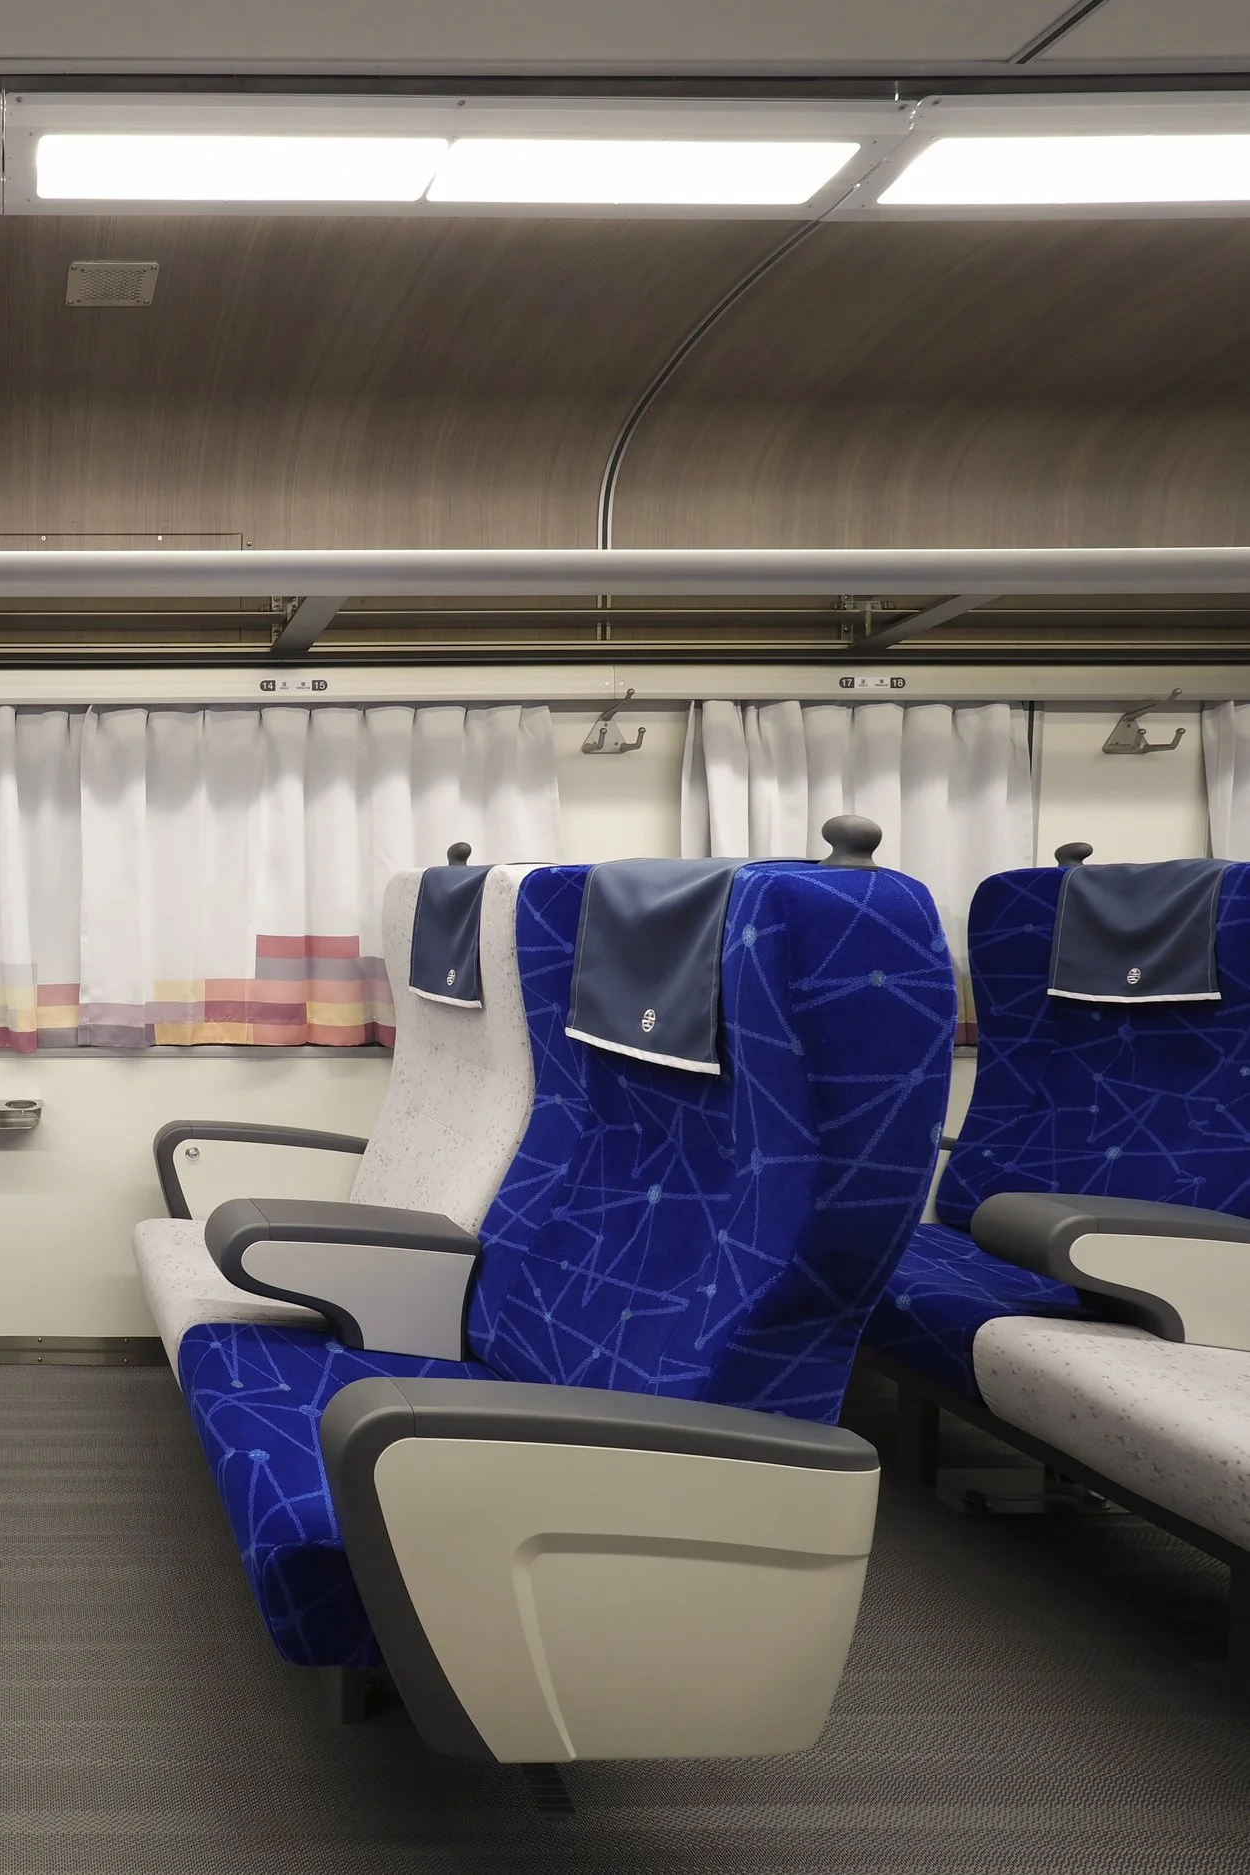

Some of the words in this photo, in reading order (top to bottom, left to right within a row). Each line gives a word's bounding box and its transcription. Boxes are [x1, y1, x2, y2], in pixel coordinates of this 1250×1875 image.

[262, 681, 274, 691] 14
[313, 681, 326, 691] 15
[841, 678, 853, 688] 17
[892, 678, 904, 688] 18
